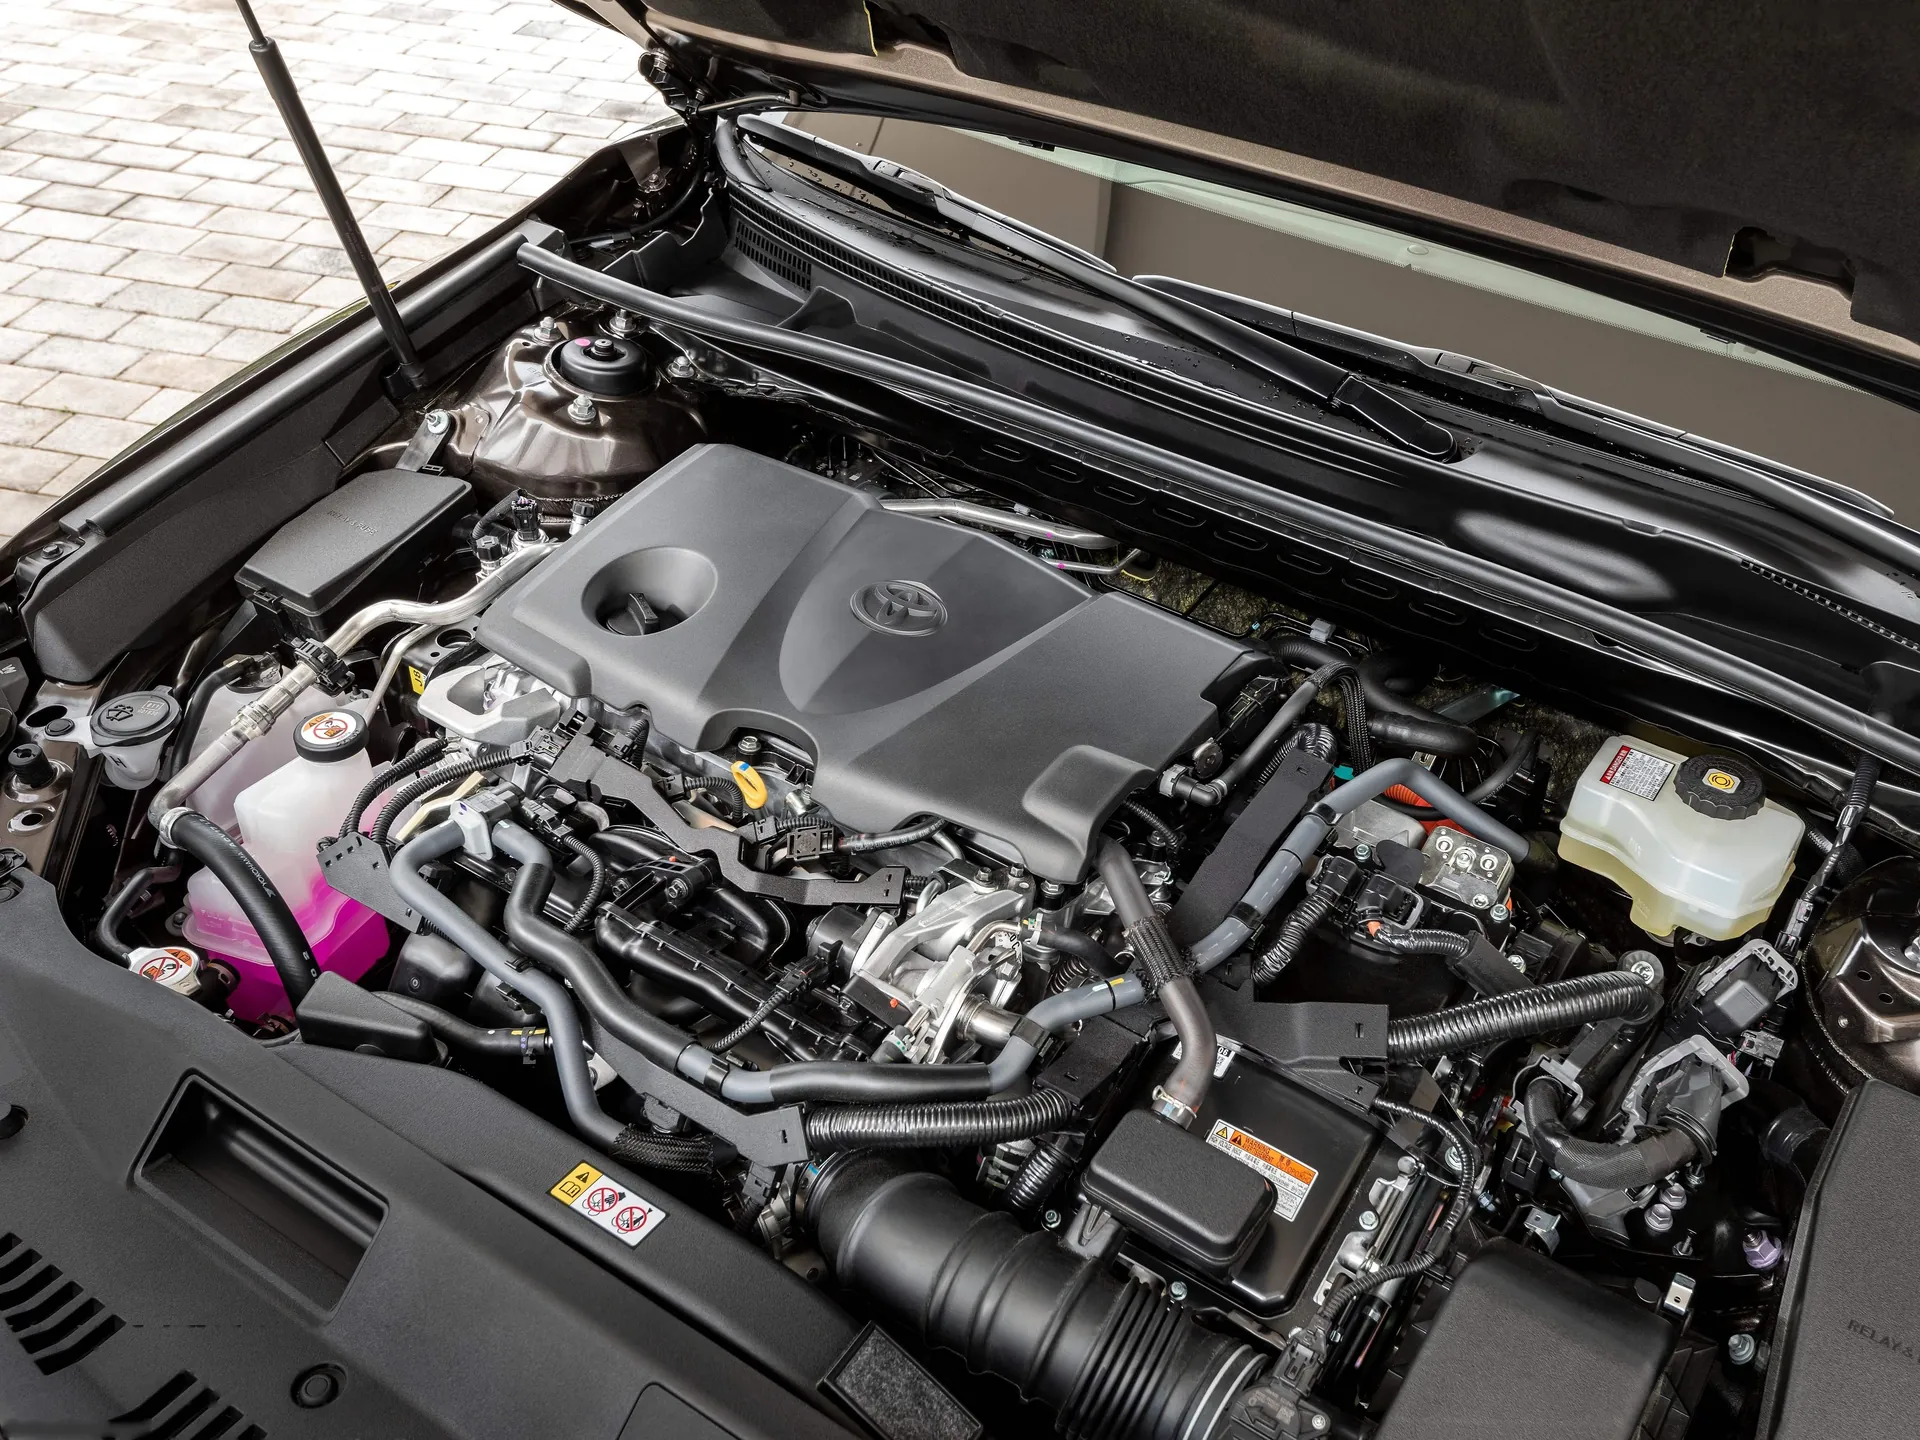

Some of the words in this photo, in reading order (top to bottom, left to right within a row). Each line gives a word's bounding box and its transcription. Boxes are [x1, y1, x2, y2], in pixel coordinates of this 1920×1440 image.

[237, 851, 268, 887] YOKOHAMA
[1244, 1136, 1271, 1154] WARNING
[1847, 1319, 1902, 1352] RELAY
